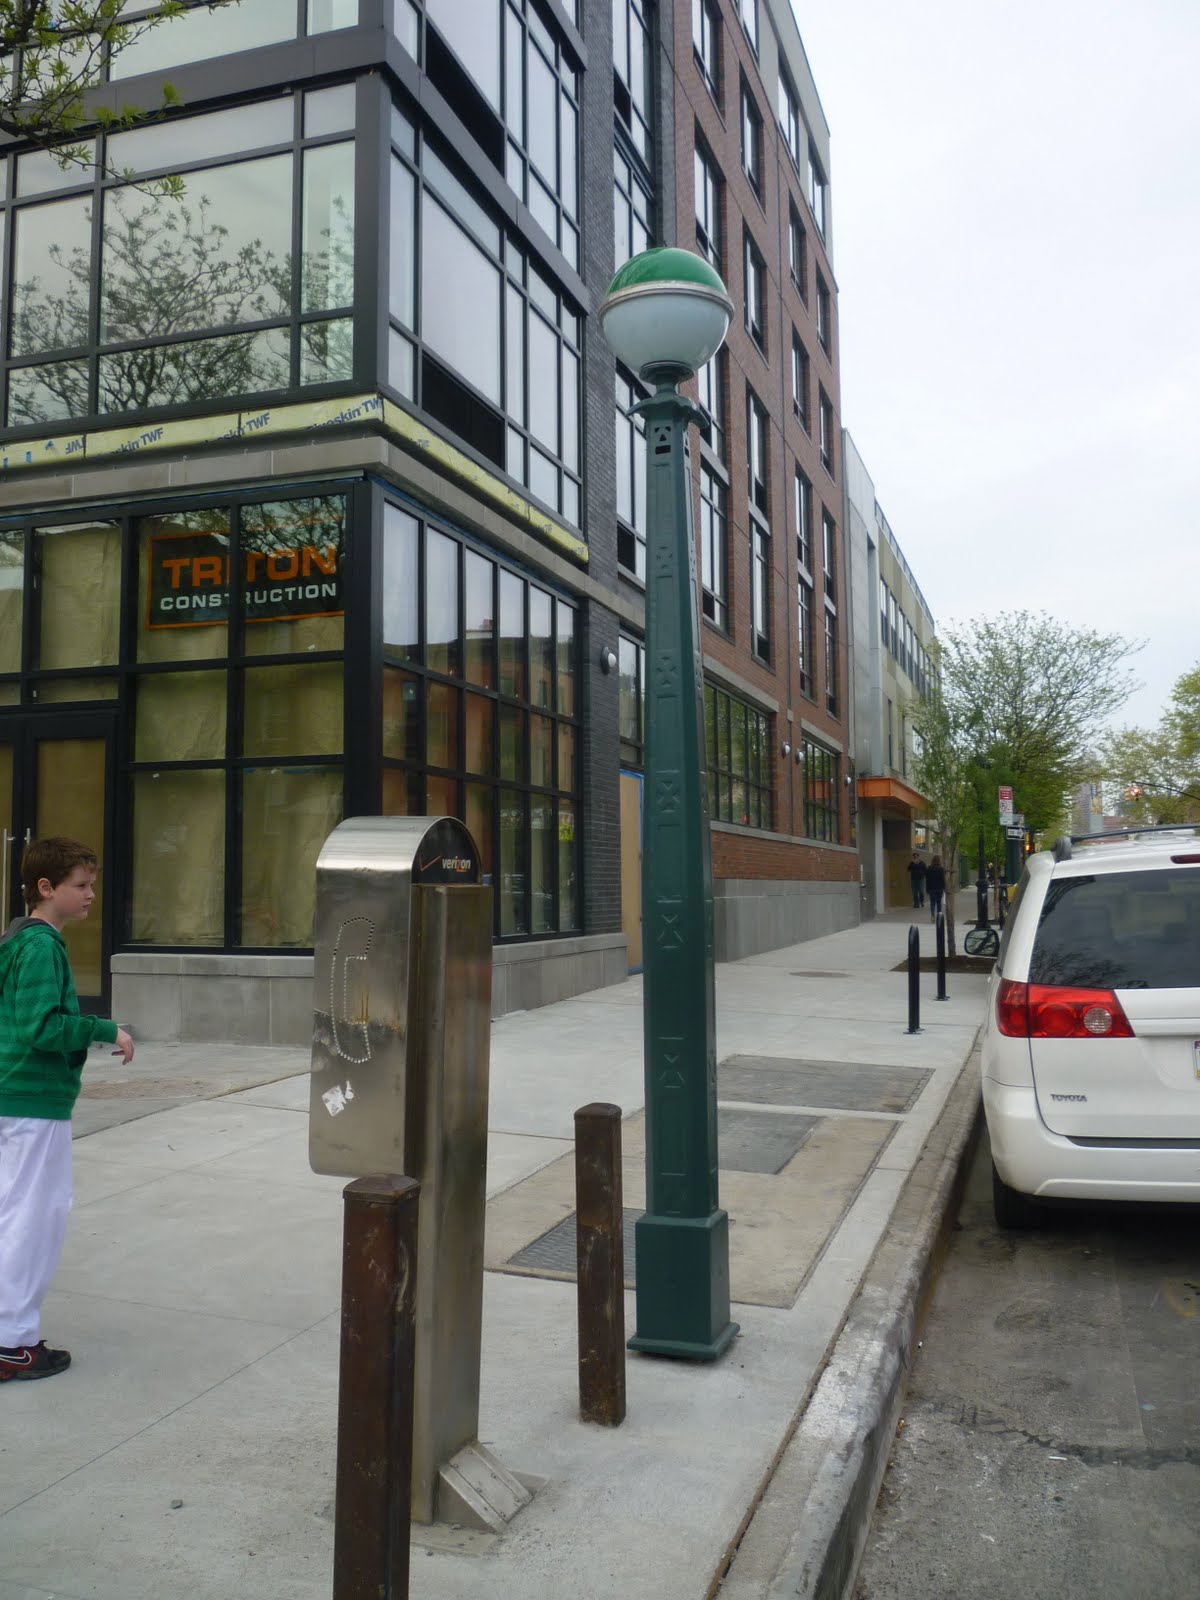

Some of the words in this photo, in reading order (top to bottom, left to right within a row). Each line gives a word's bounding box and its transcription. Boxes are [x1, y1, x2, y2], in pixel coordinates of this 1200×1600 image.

[246, 412, 270, 431] TWF
[140, 427, 163, 446] TWF
[160, 583, 337, 610] CONSUCTION
[442, 856, 472, 872] verizon
[1050, 1093, 1088, 1102] TOYOTA
